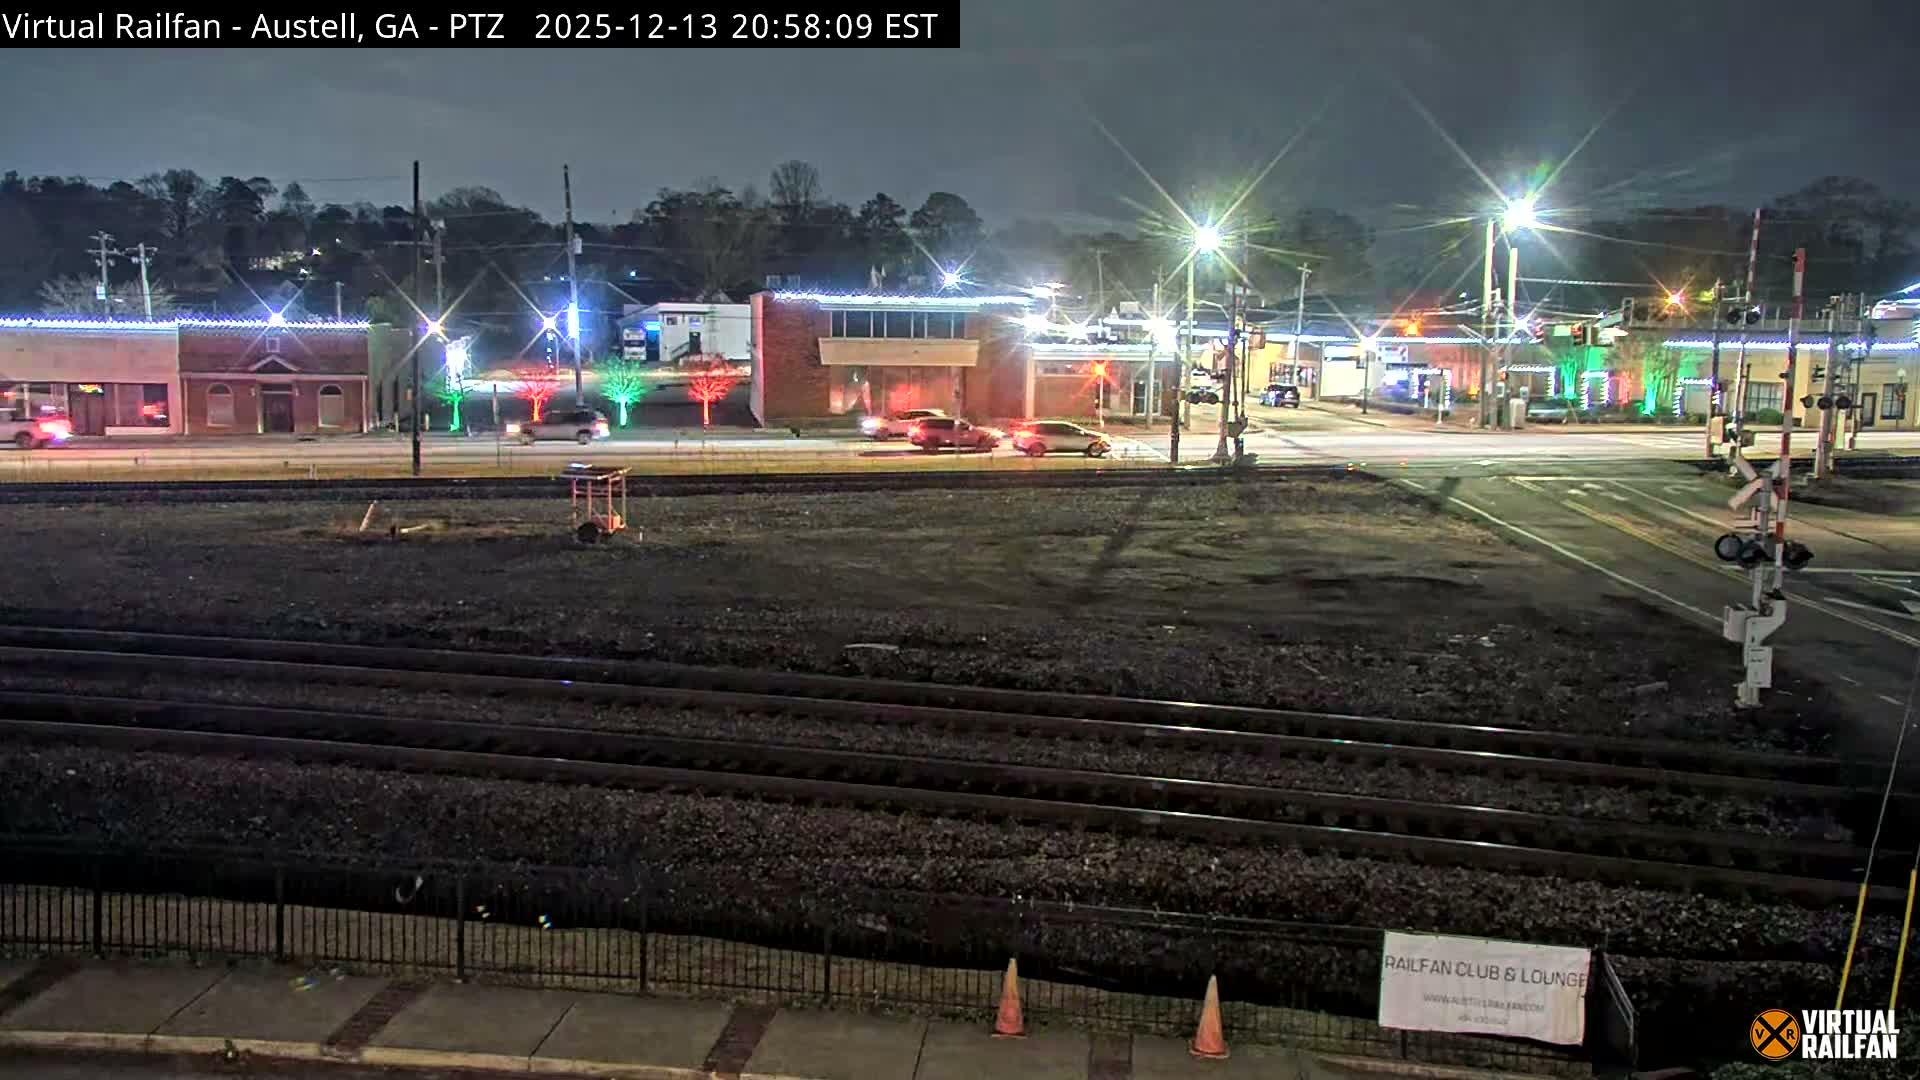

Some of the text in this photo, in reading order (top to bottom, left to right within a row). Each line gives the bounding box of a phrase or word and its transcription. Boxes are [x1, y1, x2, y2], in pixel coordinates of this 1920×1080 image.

[1385, 955, 1589, 988] RAILFAN CLUB & LOUNGE
